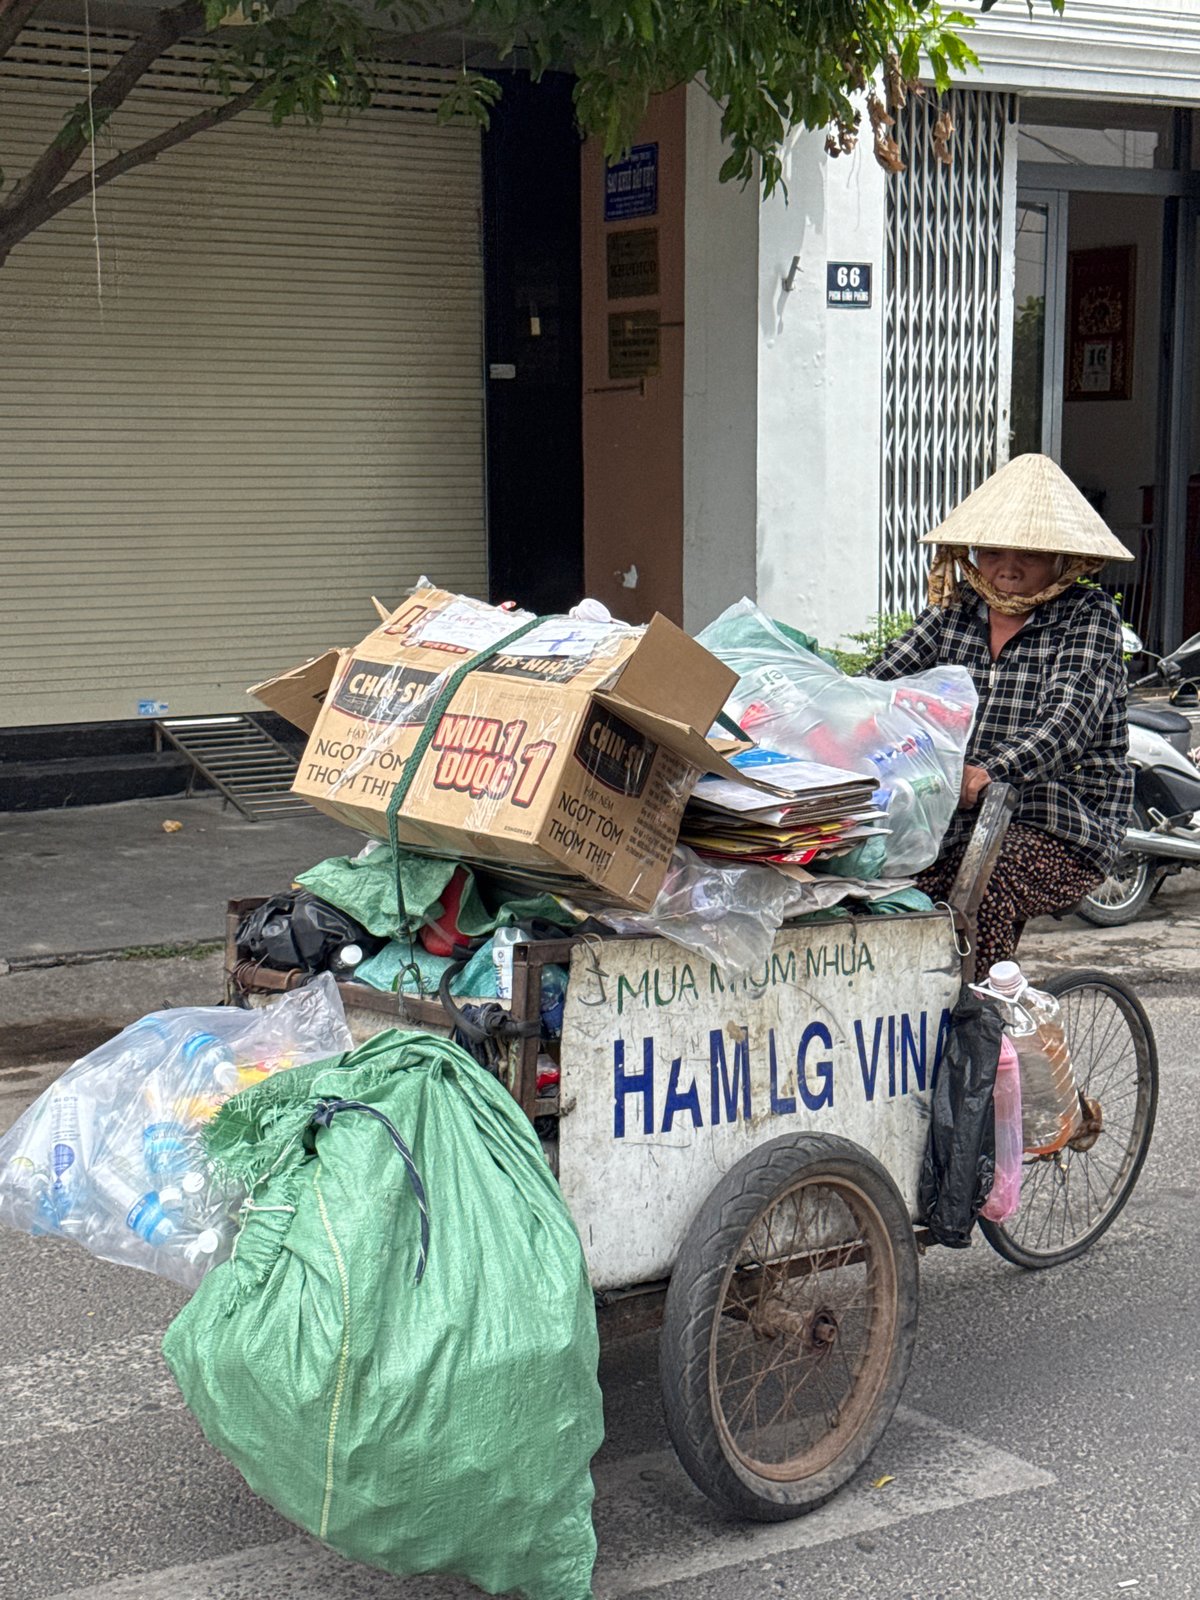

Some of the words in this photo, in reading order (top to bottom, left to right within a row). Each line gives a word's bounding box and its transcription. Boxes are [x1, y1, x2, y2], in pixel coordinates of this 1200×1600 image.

[837, 266, 860, 288] 66
[432, 713, 503, 755] MUA
[503, 719, 528, 761] 1
[511, 739, 557, 809] 1
[548, 818, 587, 855] THƠM
[585, 841, 614, 872] THỊT
[557, 791, 597, 827] NGỌT
[595, 814, 625, 846] TÔM
[617, 963, 699, 1016] MUA
[613, 1026, 752, 1139] HAM
[768, 1021, 834, 1116] LG
